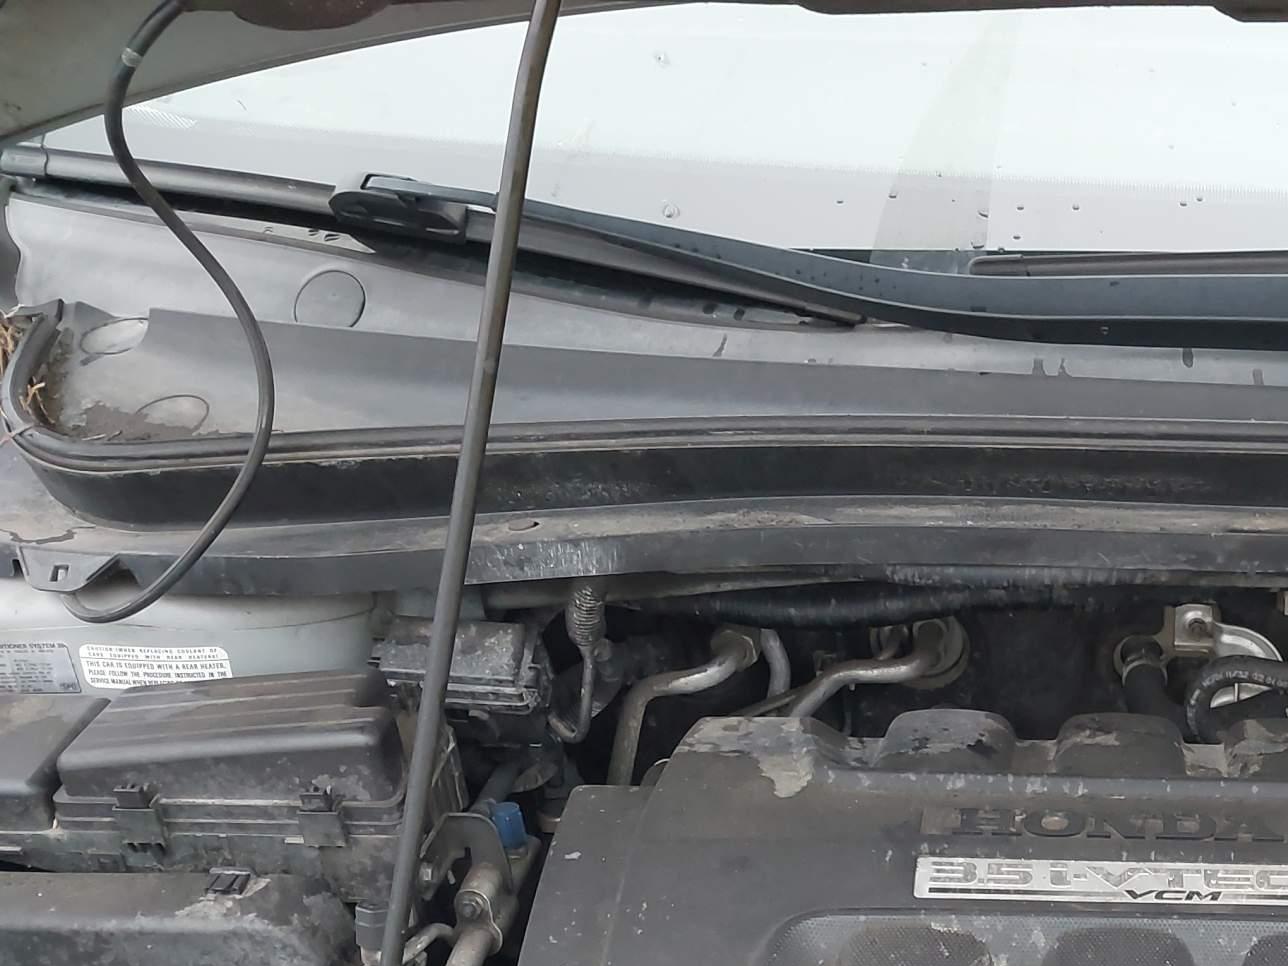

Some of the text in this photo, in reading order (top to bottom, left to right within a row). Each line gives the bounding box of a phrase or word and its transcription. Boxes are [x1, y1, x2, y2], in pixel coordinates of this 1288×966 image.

[87, 660, 100, 668] THIS
[124, 662, 155, 670] EQUIPPED
[952, 808, 1286, 842] HONDA
[928, 860, 1033, 887] 3.5
[1123, 888, 1223, 902] VCM
